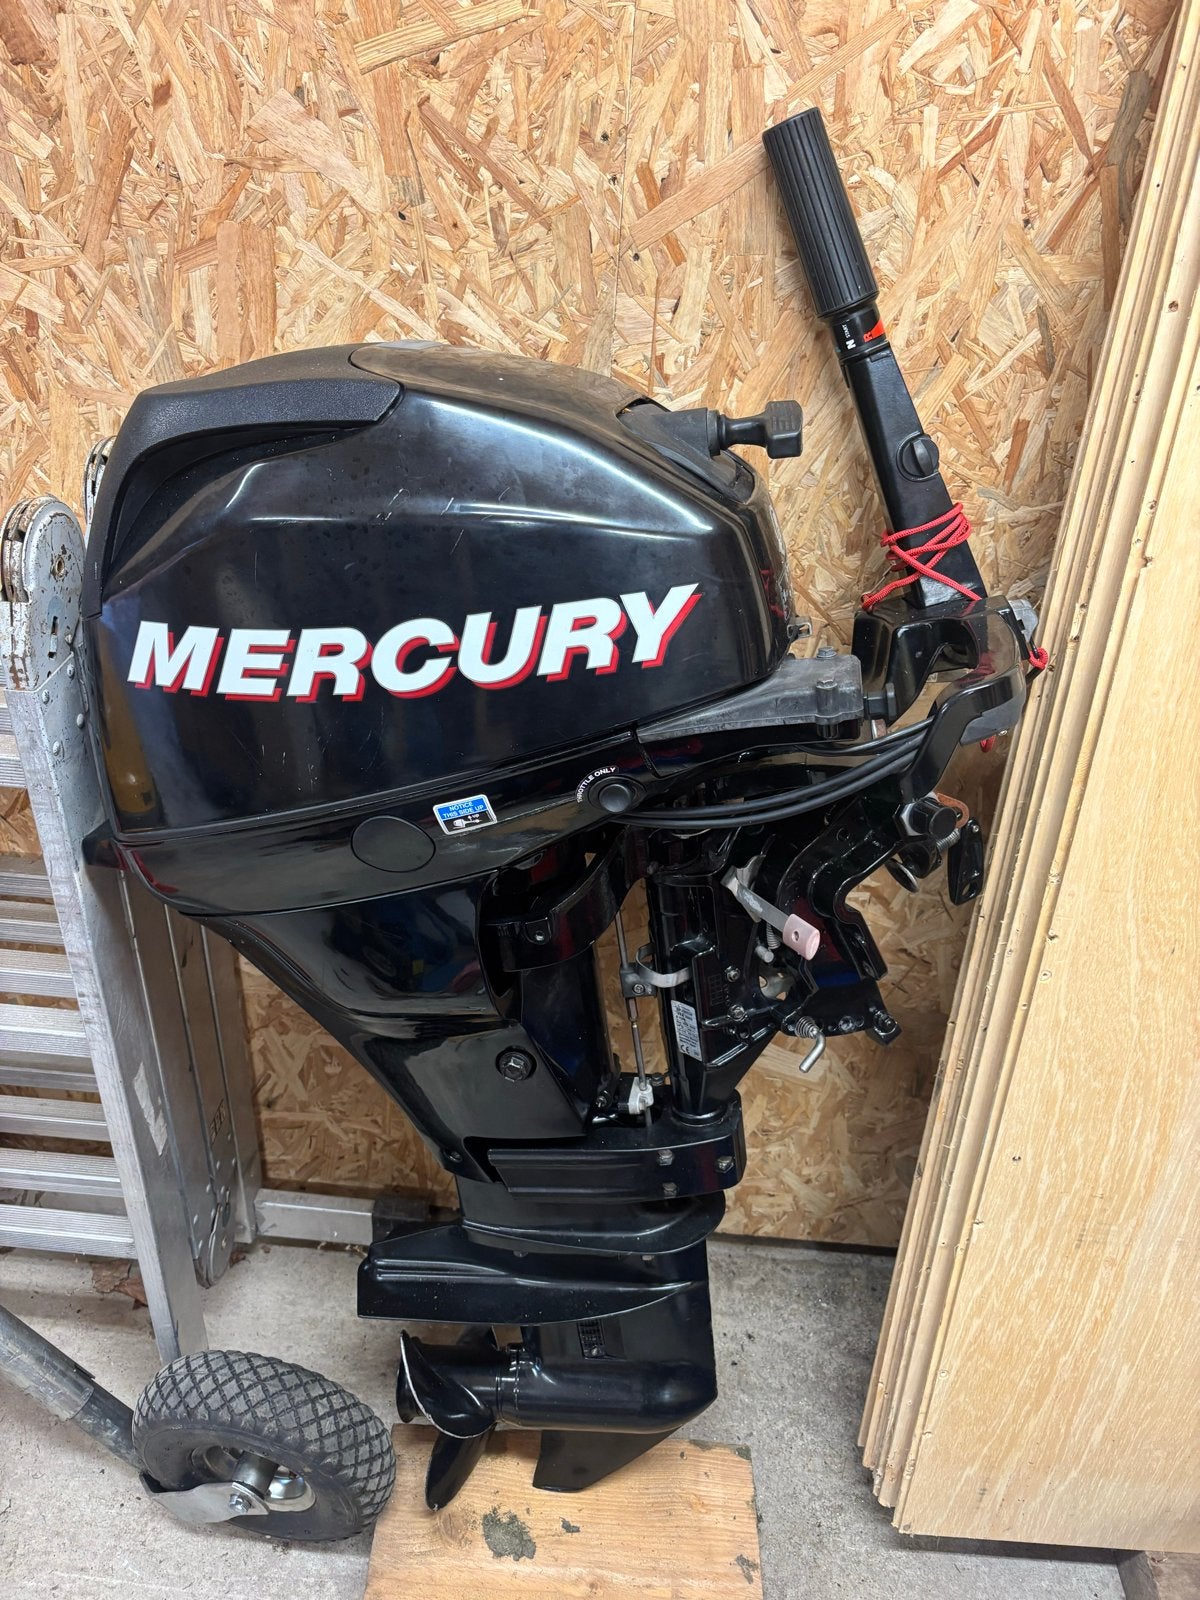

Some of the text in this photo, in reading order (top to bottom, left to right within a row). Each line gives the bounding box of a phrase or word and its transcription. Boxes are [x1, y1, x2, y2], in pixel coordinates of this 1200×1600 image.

[864, 332, 873, 343] R
[845, 339, 856, 350] N
[127, 582, 702, 702] MERCURY
[577, 767, 616, 803] THROTTLE ONLY
[449, 802, 473, 812] NOTICE
